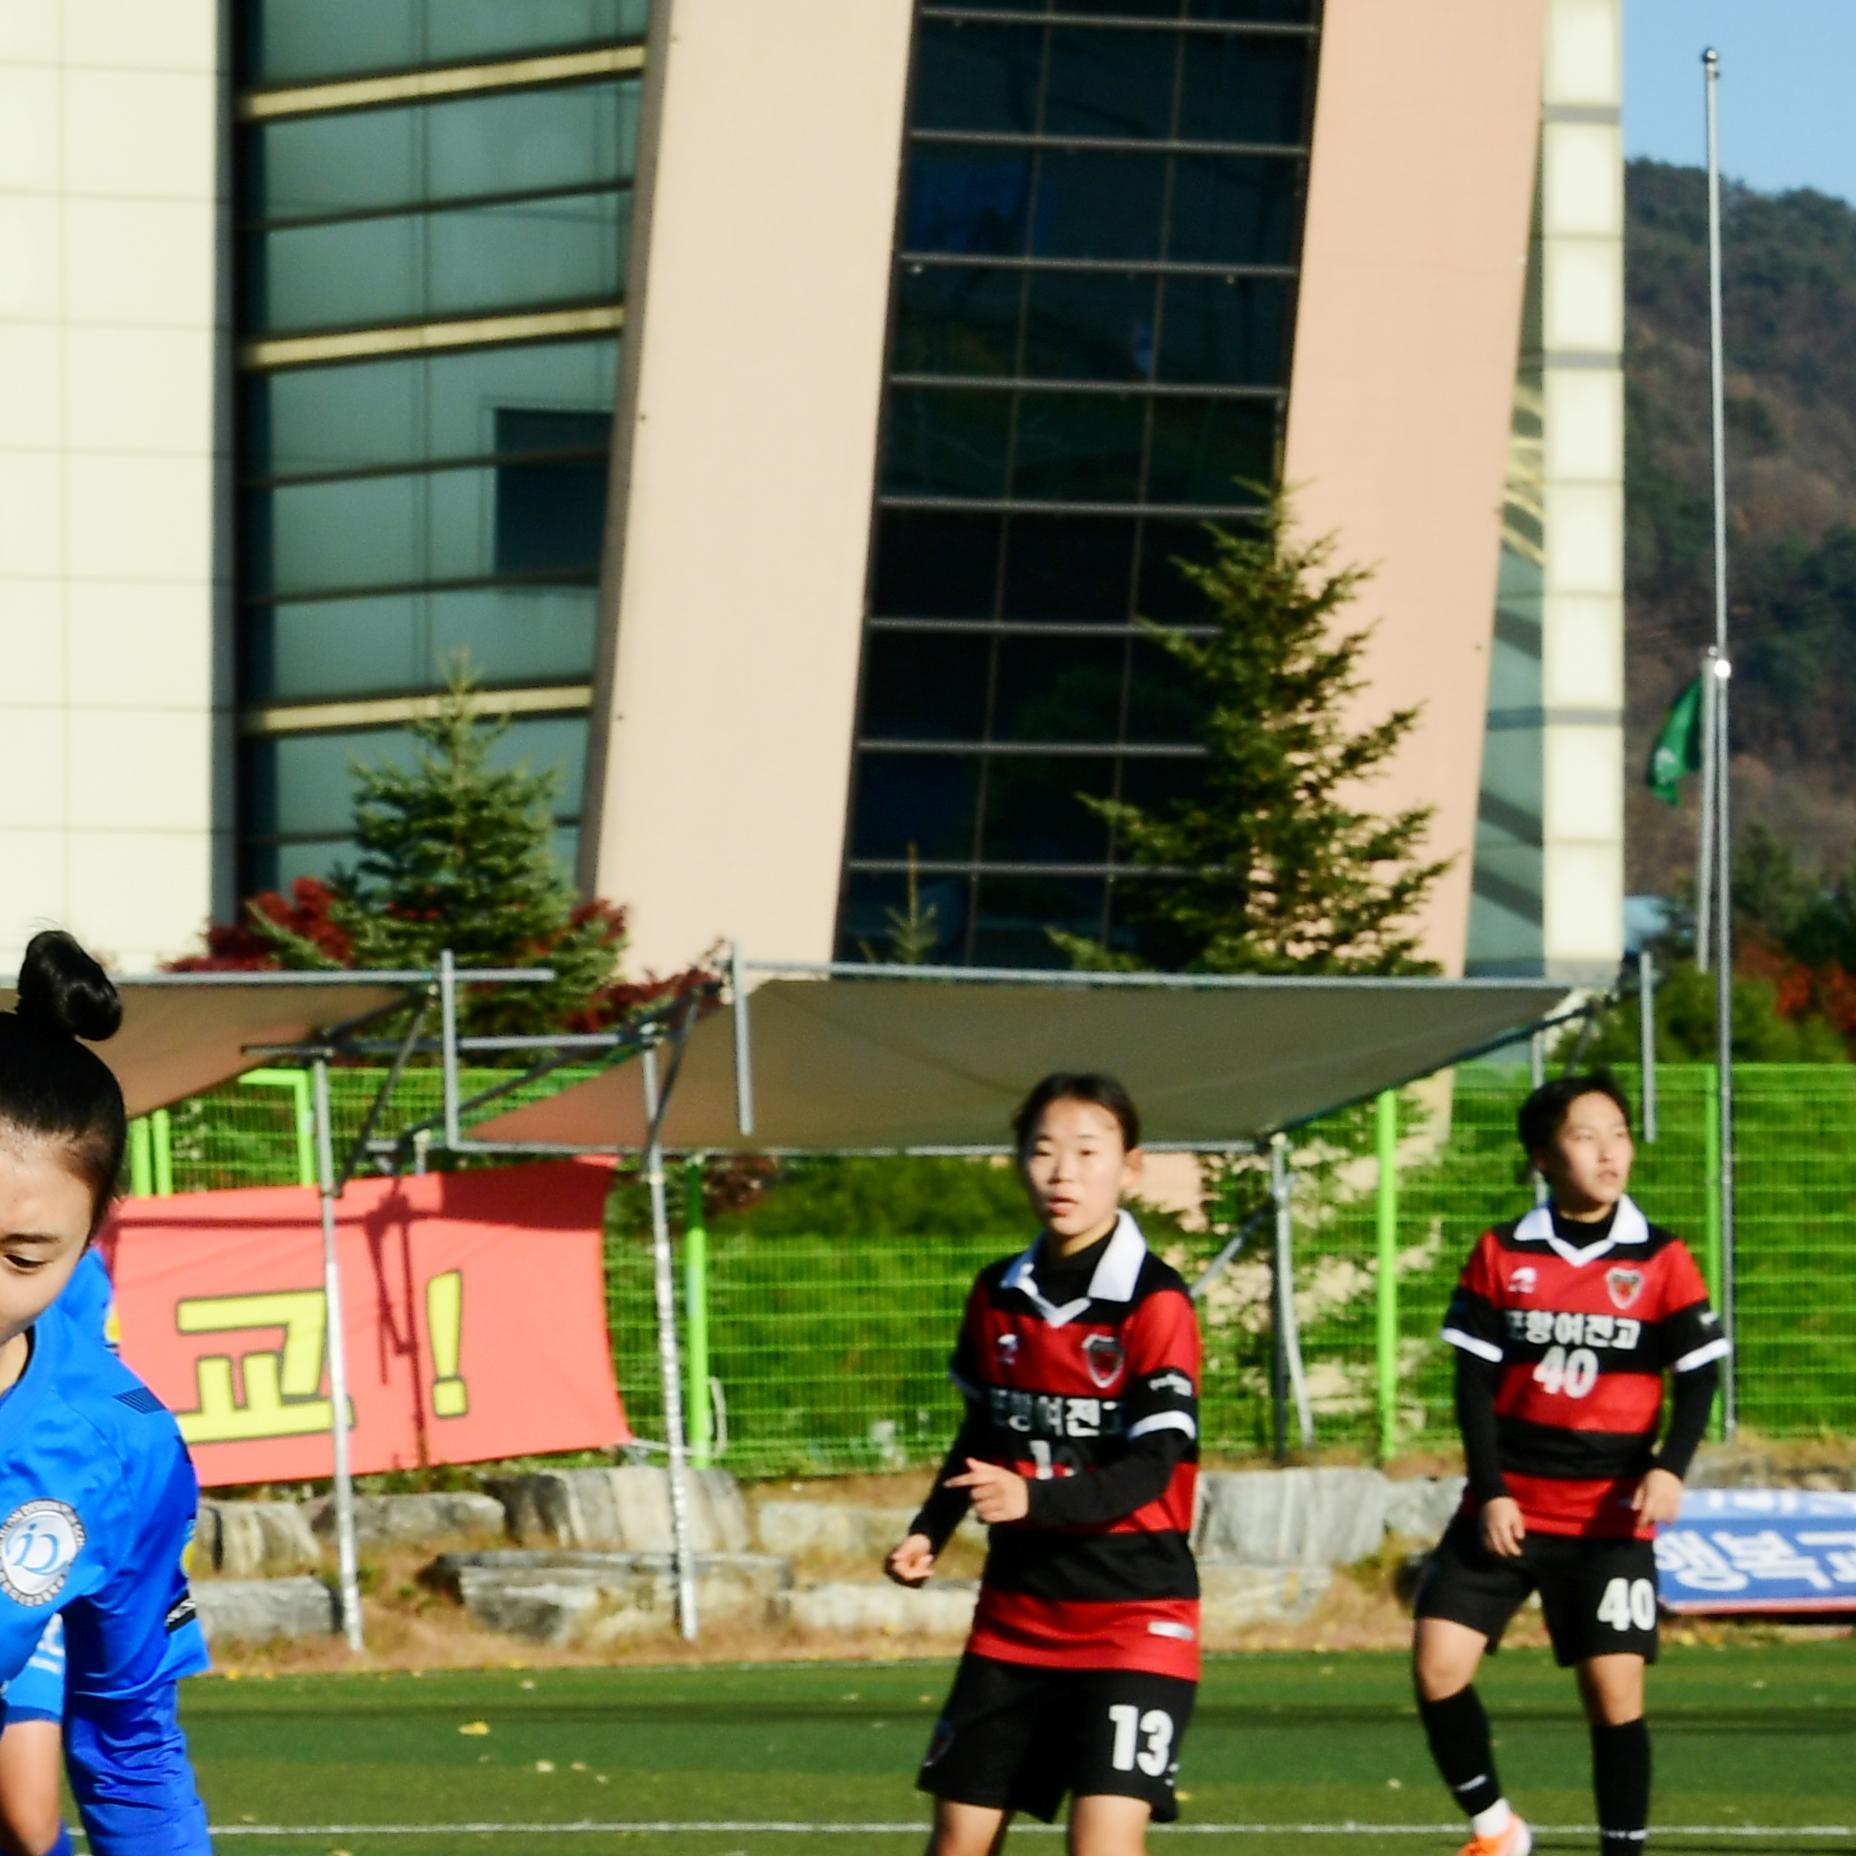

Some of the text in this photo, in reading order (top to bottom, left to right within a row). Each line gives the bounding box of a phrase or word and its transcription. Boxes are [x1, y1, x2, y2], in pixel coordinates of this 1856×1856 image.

[1533, 1345, 1598, 1399] 40
[1597, 1577, 1656, 1631] 40
[1108, 1704, 1175, 1777] 13
